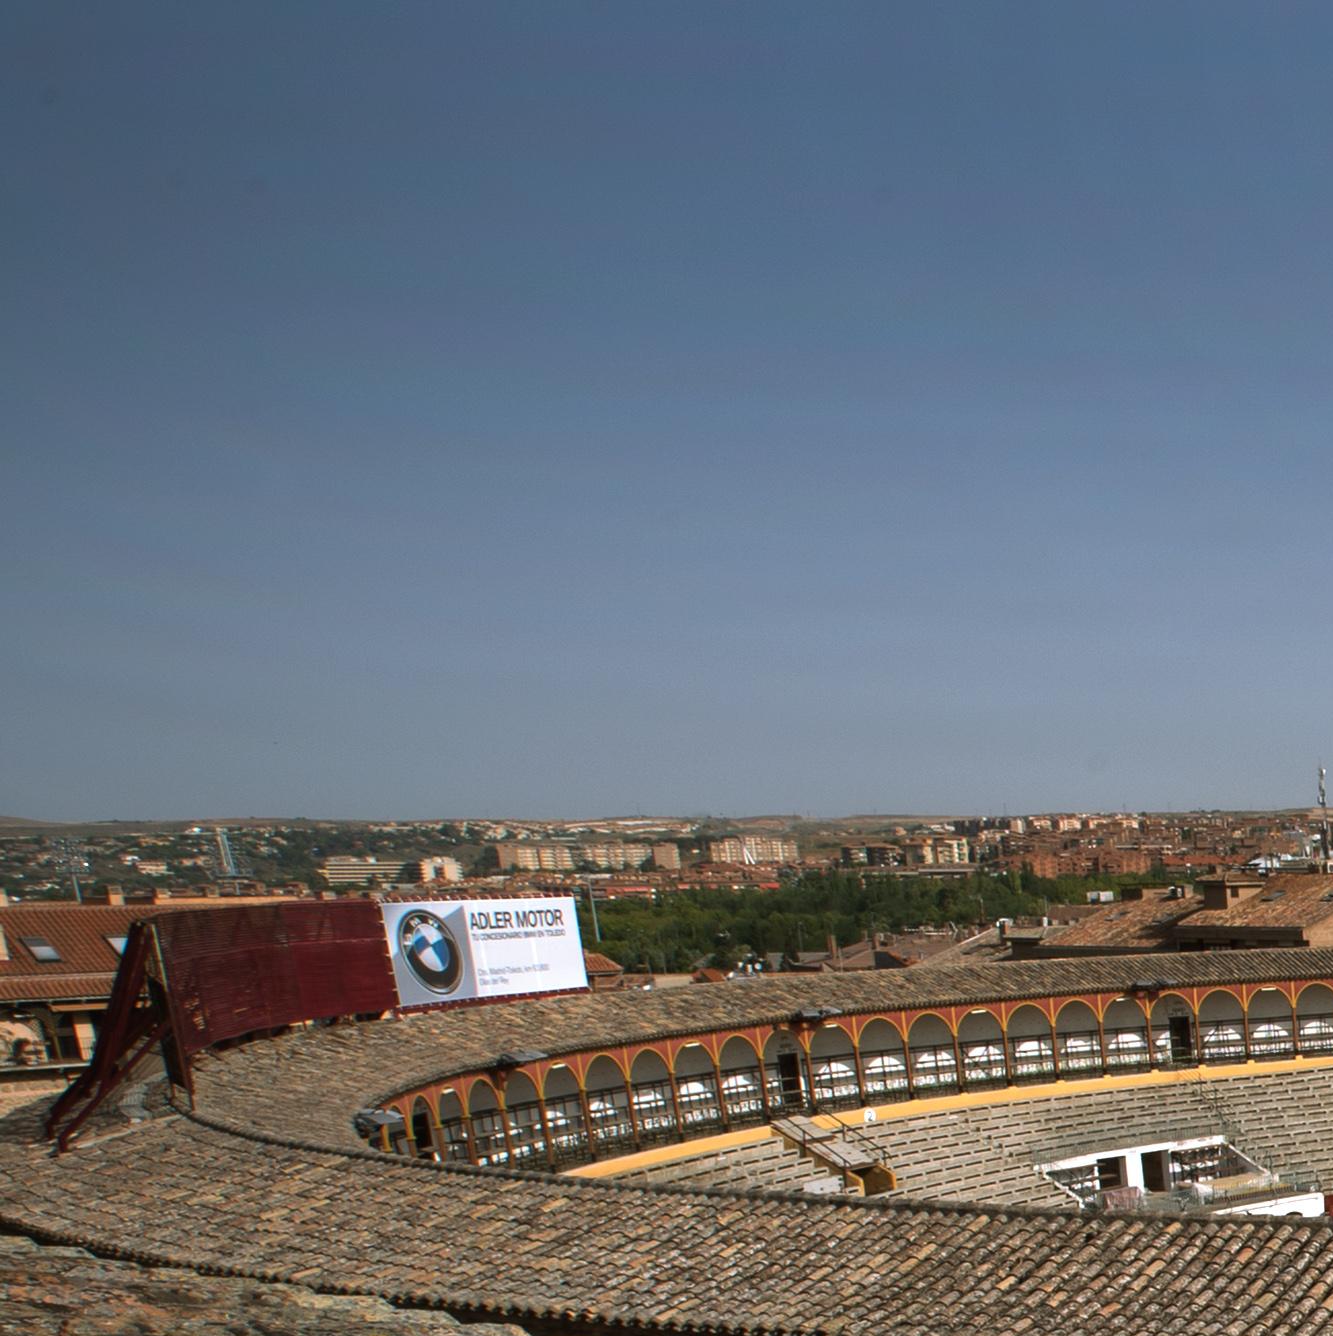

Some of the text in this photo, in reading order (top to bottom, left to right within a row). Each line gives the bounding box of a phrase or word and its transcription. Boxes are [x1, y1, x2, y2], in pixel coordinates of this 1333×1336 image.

[470, 908, 564, 930] ADLER MOTOR
[545, 929, 566, 937] TOLEDO
